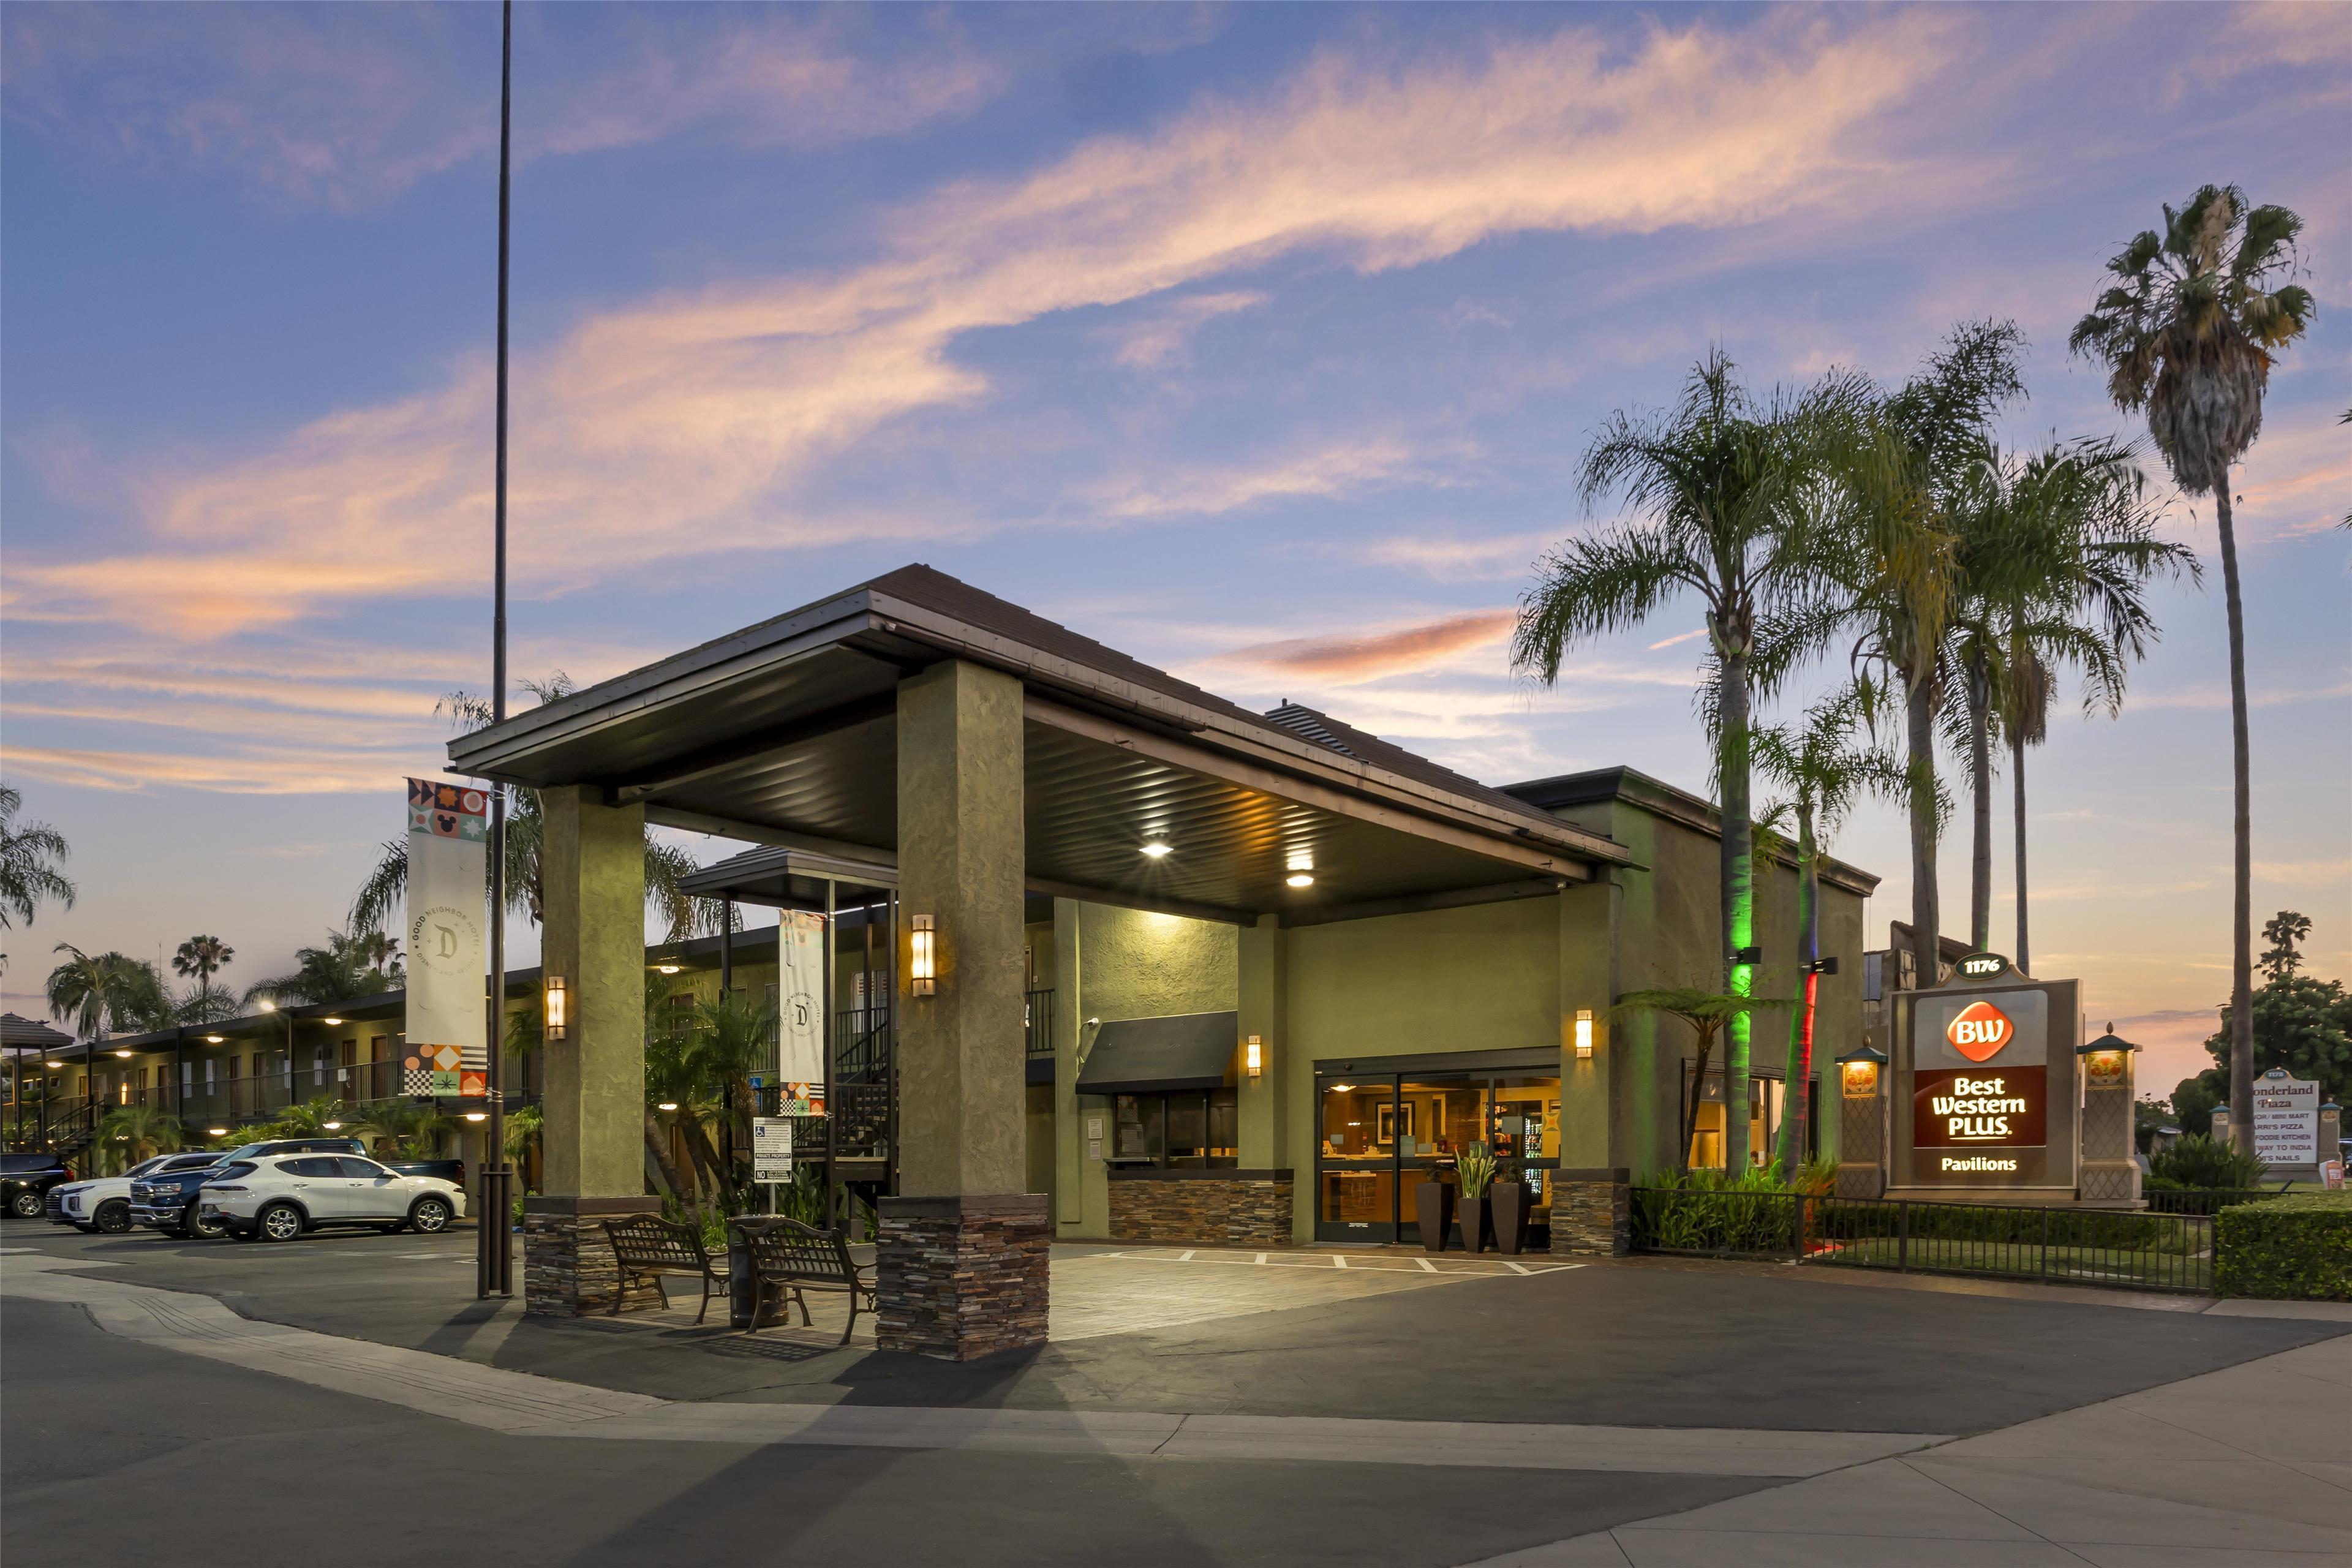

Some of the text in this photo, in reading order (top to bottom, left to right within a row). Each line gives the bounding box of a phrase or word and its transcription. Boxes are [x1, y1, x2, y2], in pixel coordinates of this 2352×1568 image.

[412, 907, 480, 947] GOOD NEIGHBOR HOTEL
[434, 923, 458, 959] D
[1964, 959, 2000, 973] 1176
[795, 1004, 807, 1026] D
[1956, 1019, 2004, 1044] BW
[1954, 1078, 2005, 1096] Best
[2253, 1085, 2313, 1096] onderland
[1932, 1096, 2026, 1115] Western
[1942, 1157, 2017, 1170] Pavilions
